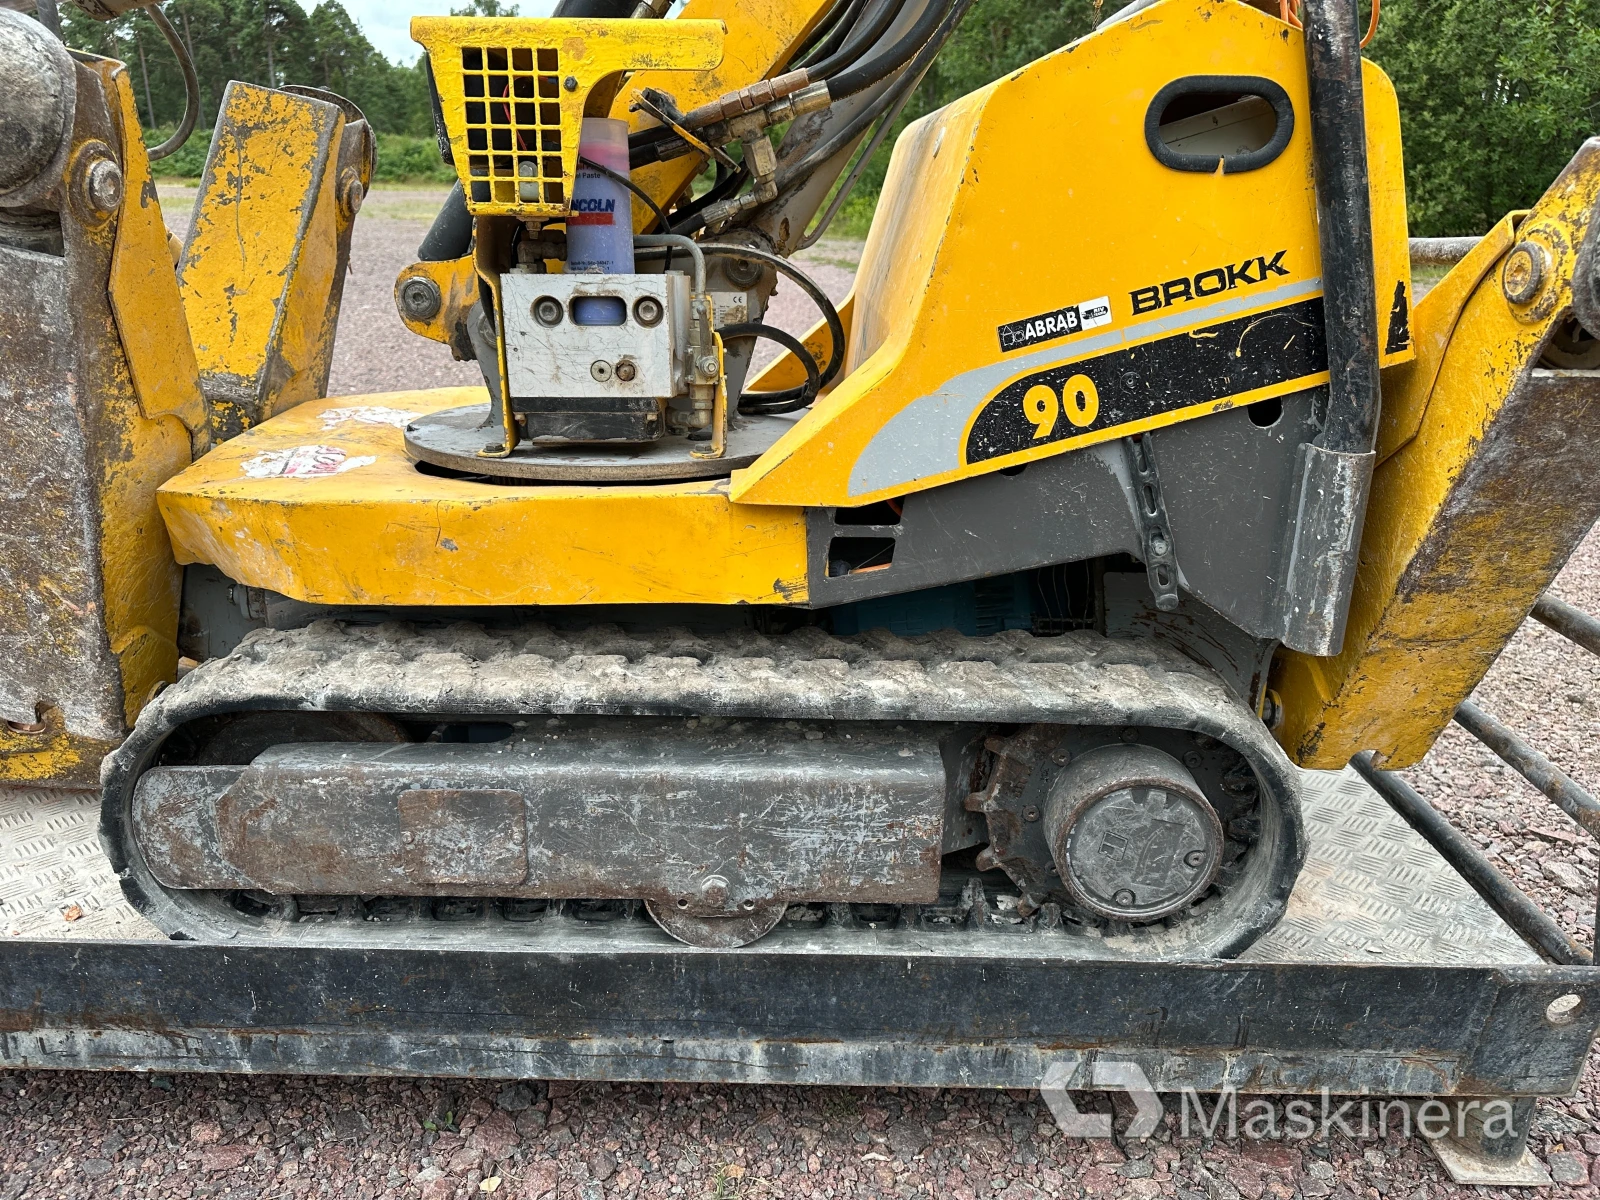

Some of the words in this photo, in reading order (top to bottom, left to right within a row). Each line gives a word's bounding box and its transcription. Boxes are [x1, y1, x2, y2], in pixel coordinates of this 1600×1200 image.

[571, 198, 616, 212] NCOLN
[1128, 250, 1290, 315] BROKK
[1025, 311, 1078, 340] ABRAB
[1023, 374, 1099, 439] 90
